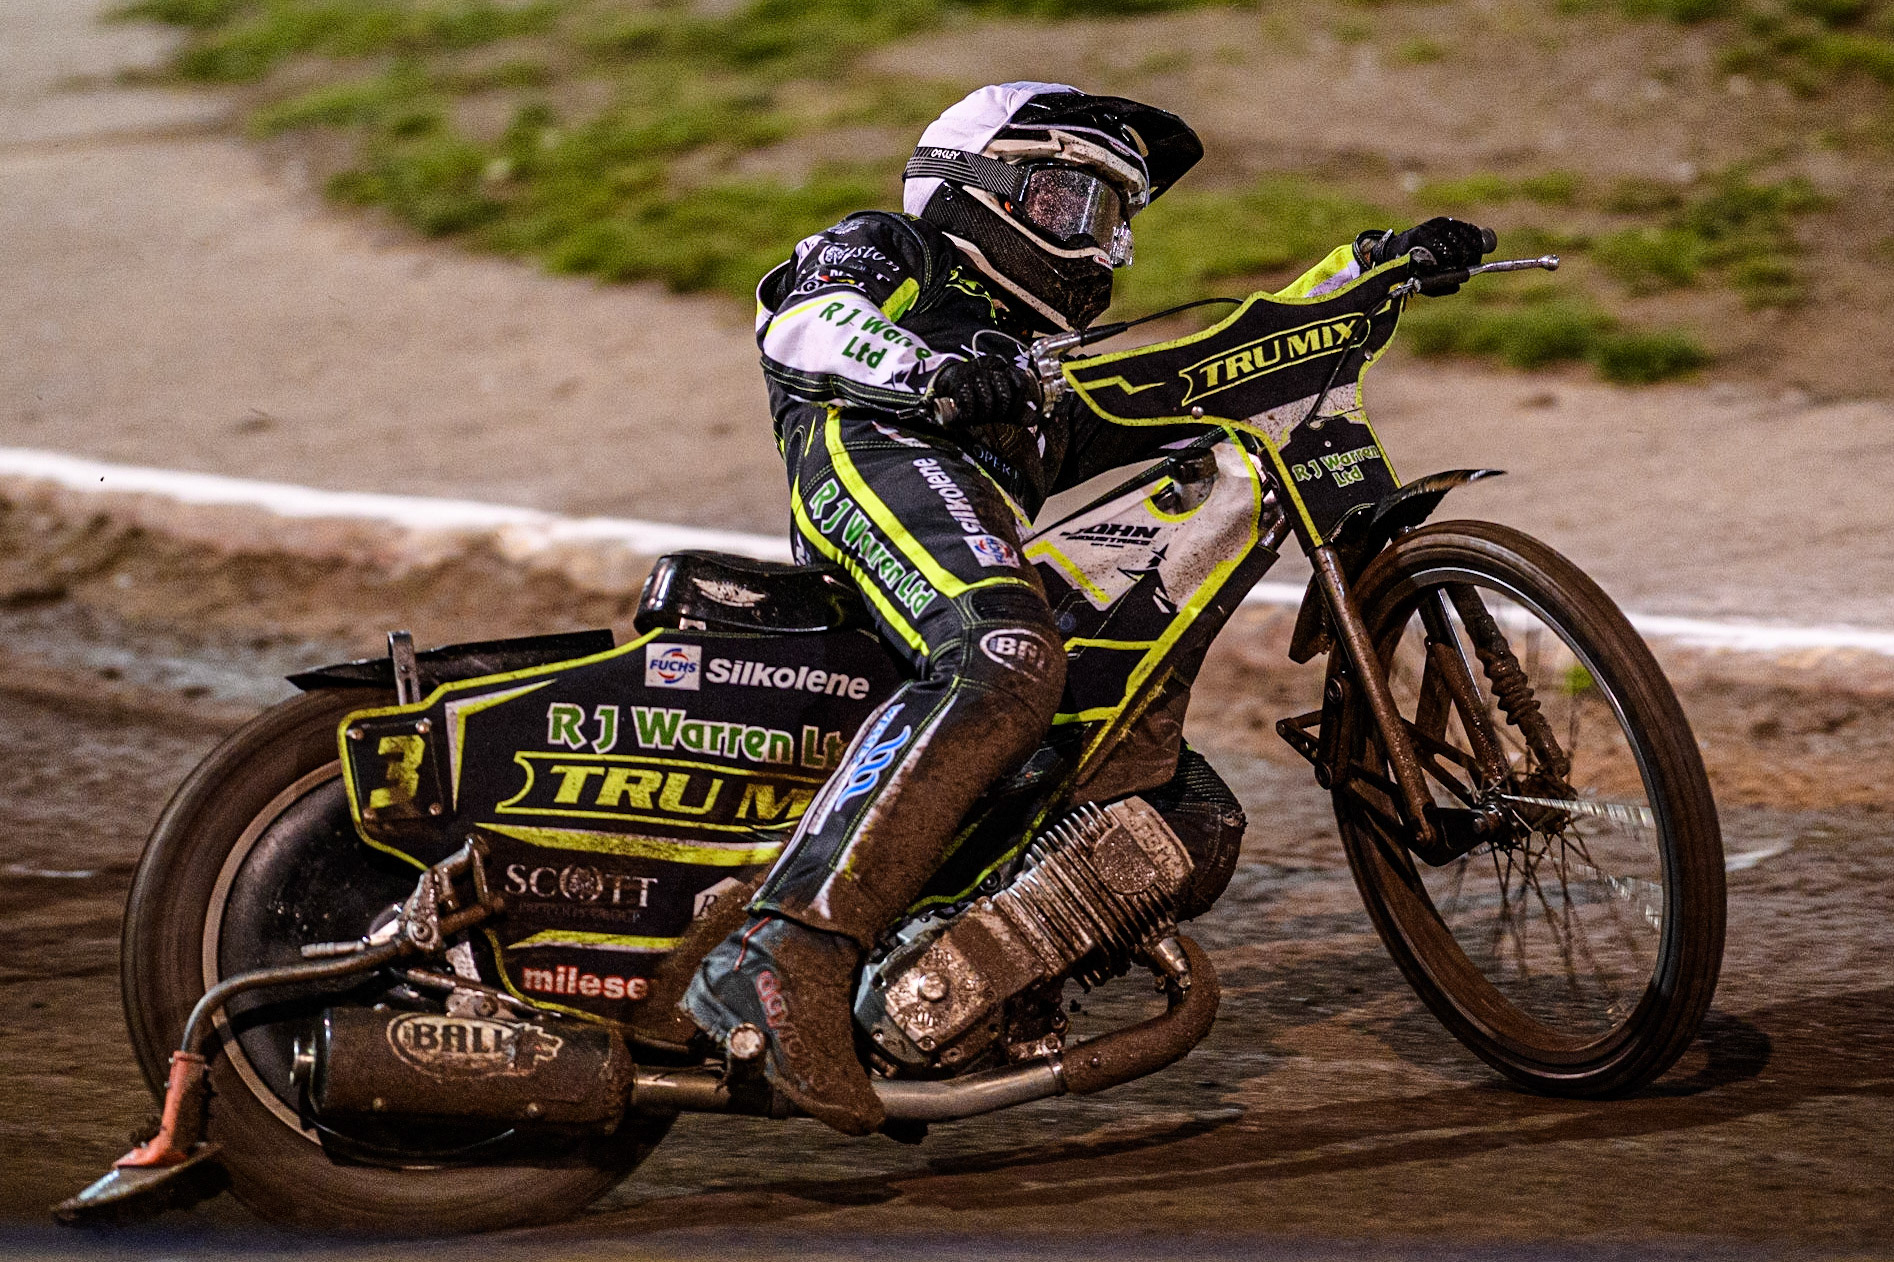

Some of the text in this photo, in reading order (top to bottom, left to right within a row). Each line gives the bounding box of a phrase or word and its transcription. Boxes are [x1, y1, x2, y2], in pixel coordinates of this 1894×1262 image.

[818, 302, 845, 321] R
[835, 308, 862, 327] J
[841, 335, 888, 369] Ltd
[1199, 319, 1357, 388] TRU MIX
[1291, 444, 1381, 483] R J Warren
[1331, 464, 1365, 488] Ltd
[808, 477, 938, 620] R J Warren Ltd
[649, 658, 698, 674] FUCHS
[705, 657, 870, 700] Silkolene
[546, 702, 846, 770] R J Warren Lt
[367, 733, 426, 814] 3
[550, 764, 724, 815] TRU
[504, 863, 658, 907] SCOTT
